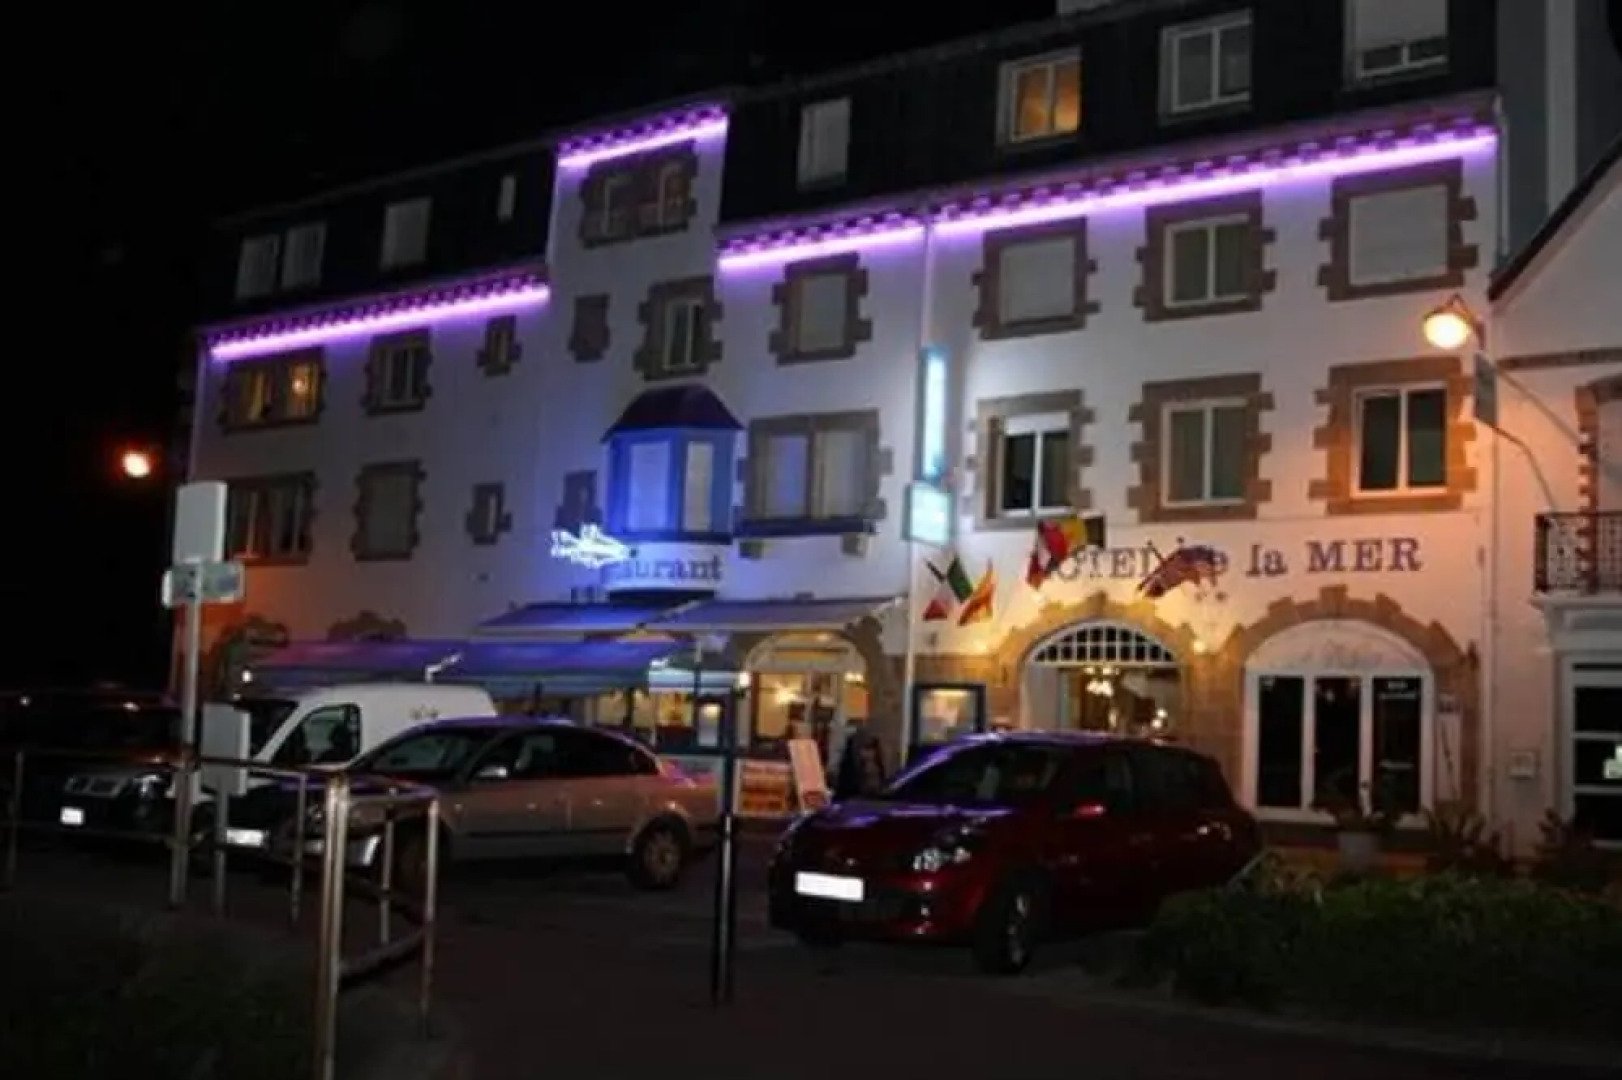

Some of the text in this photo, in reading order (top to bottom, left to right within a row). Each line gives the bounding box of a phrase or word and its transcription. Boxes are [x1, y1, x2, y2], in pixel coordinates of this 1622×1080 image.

[1055, 544, 1154, 580] OTEL
[1246, 543, 1288, 577] la
[1305, 537, 1423, 573] MER
